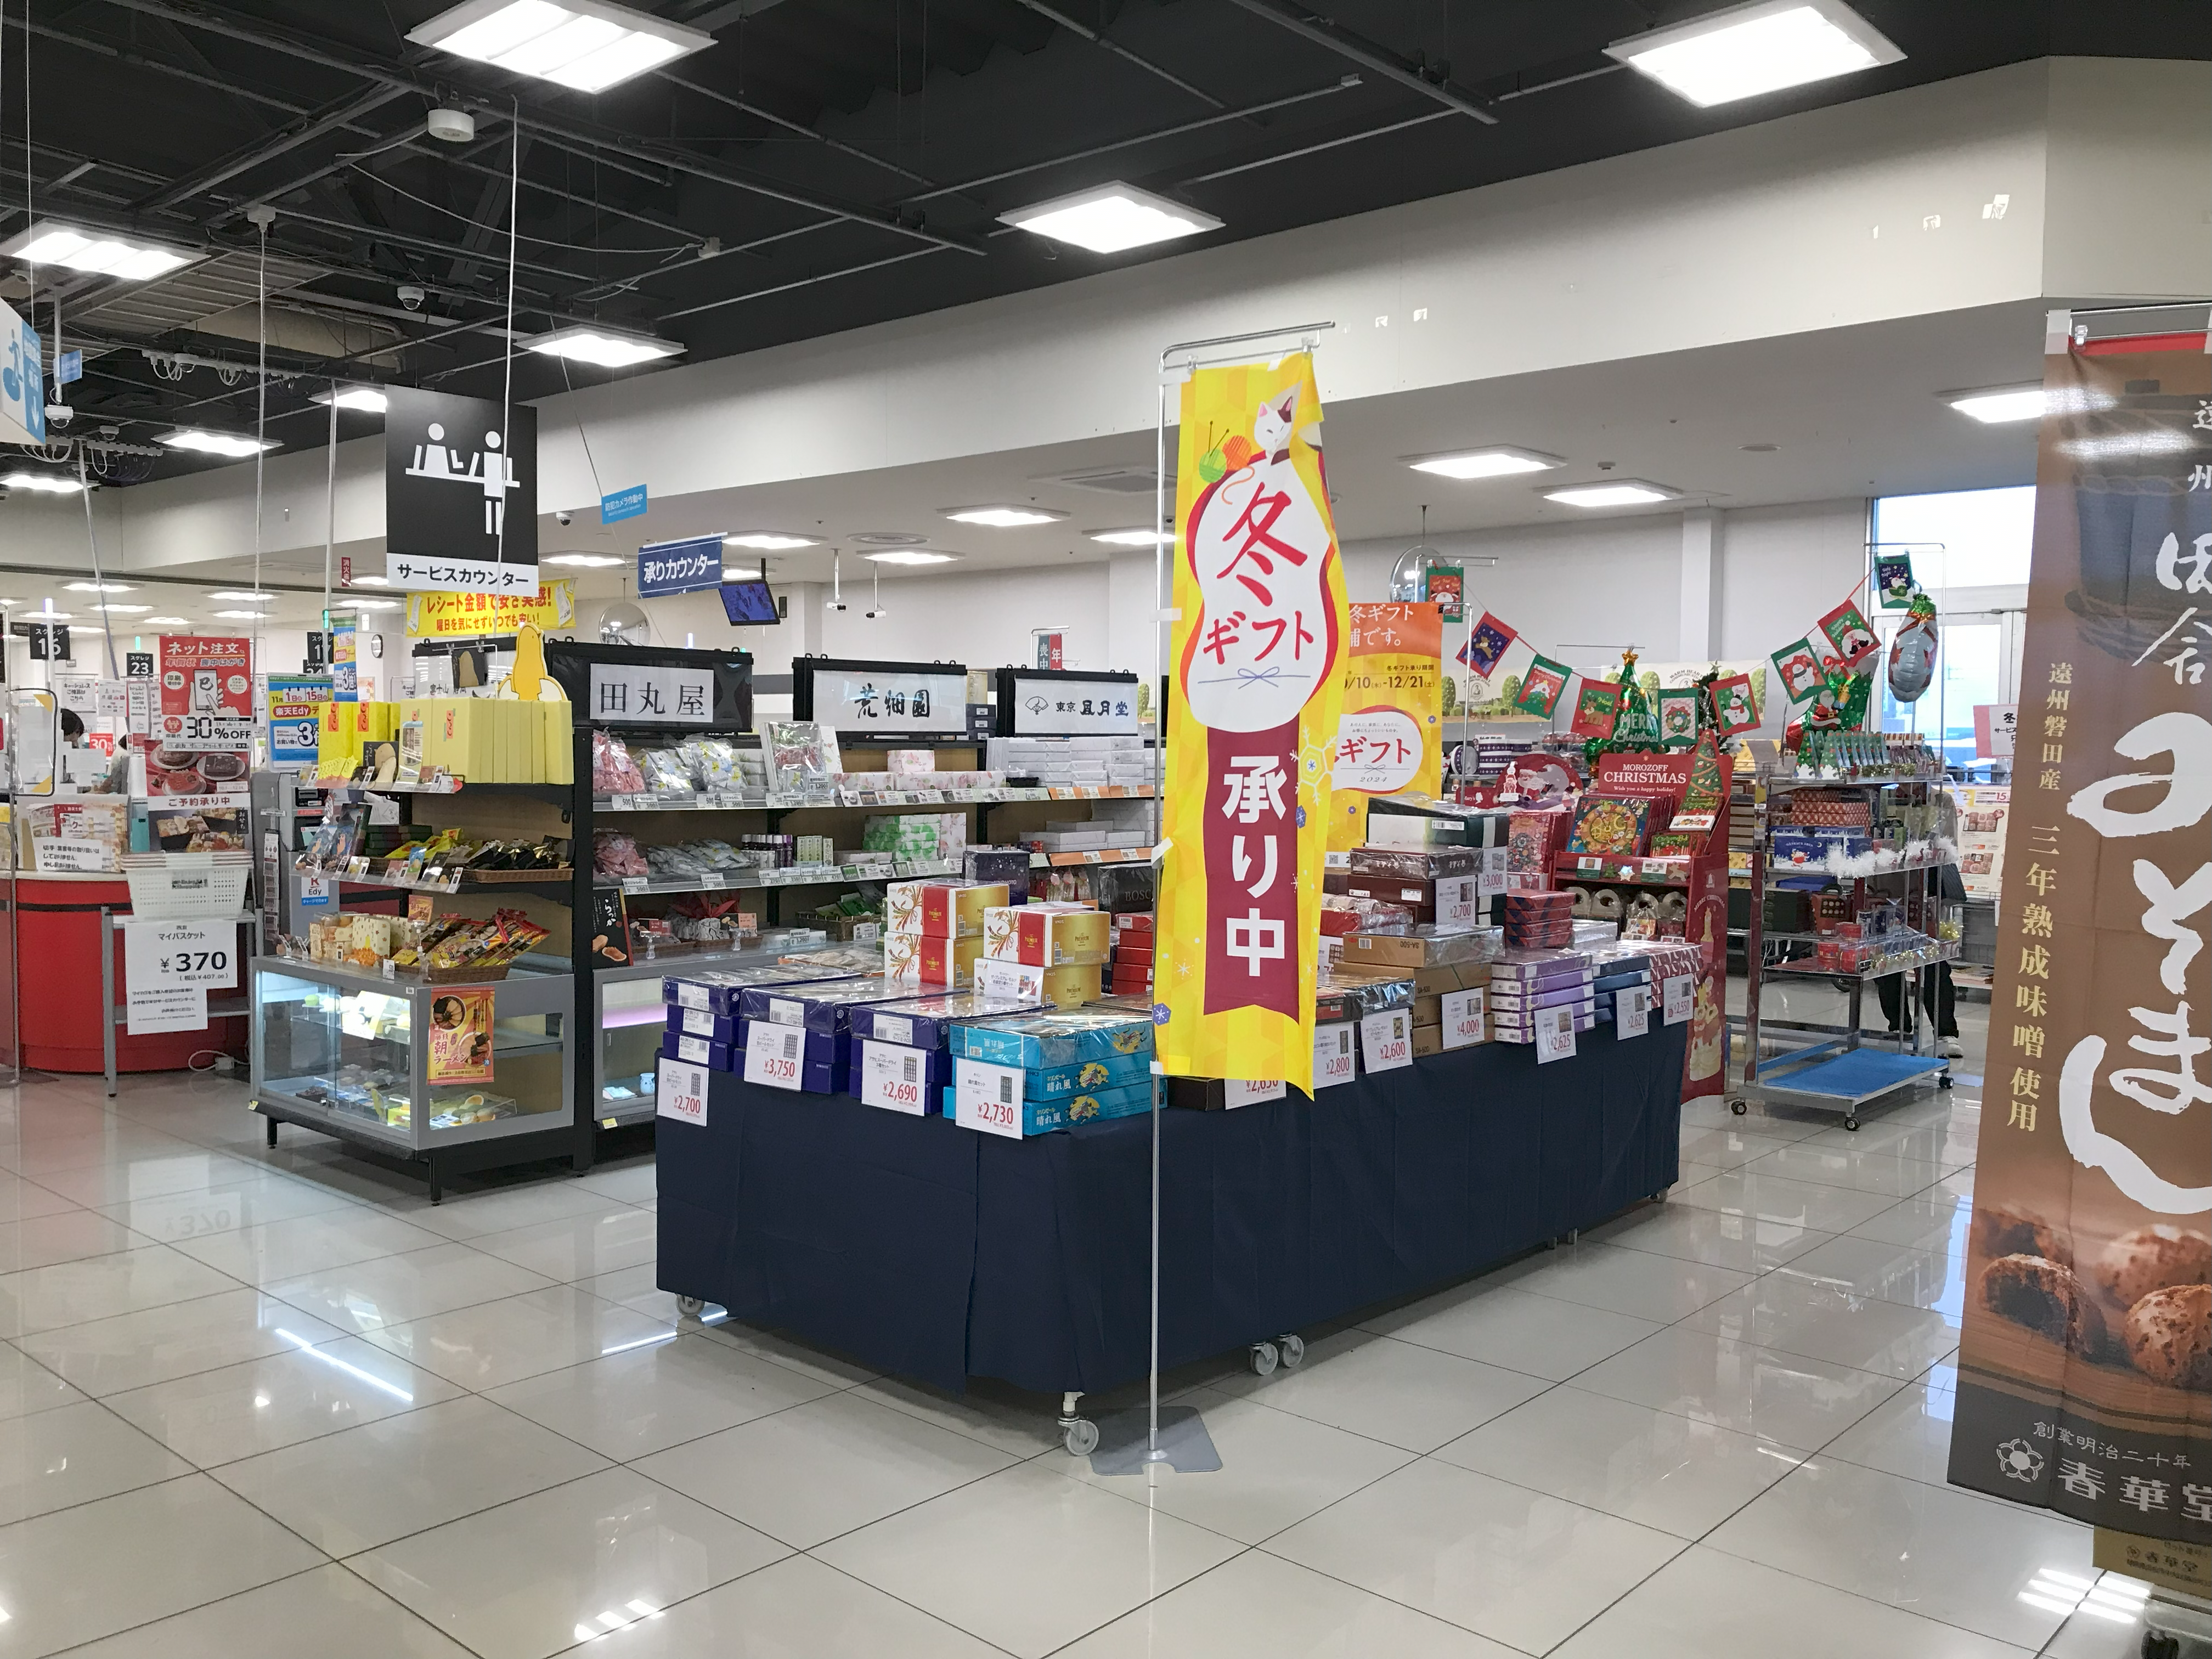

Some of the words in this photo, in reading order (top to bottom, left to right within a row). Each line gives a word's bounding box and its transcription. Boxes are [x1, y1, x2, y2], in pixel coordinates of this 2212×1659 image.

[605, 493, 644, 511] 防犯カメラ作動中
[1217, 481, 1308, 607] 冬
[397, 563, 529, 586] サービスカウンター
[644, 554, 719, 584] 承りカウンター
[1350, 604, 1414, 624] 冬ギフト
[1203, 610, 1313, 664] ギフト
[1039, 643, 1049, 669] 喪中
[1051, 647, 1062, 669] 年
[131, 663, 149, 674] 23
[600, 682, 705, 716] 田丸屋
[855, 682, 930, 719] 荒畑園
[1056, 702, 1076, 713] 東京
[2039, 663, 2073, 791] 遠州磐田産
[1335, 736, 1410, 764] ギフト
[1604, 772, 1686, 784] CHRISTMAS
[1623, 764, 1668, 772] MOROZOFF
[168, 797, 230, 807] ご予約承り中
[1996, 792, 2007, 800] 15
[1221, 755, 1288, 977] 承り中
[158, 932, 206, 940] マイバスケット
[176, 951, 227, 972] 370
[2007, 825, 2062, 1133] 三年熟成味噌使用
[1457, 1019, 1480, 1036] ¥4,000
[435, 1041, 448, 1055] 朝
[1380, 1041, 1406, 1060] ¥2,600
[433, 1054, 467, 1065] ラーメン
[764, 1058, 795, 1077] ¥3,750
[1325, 1056, 1350, 1075] ¥2,800
[883, 1081, 917, 1102] ¥2,690
[1047, 1079, 1071, 1092] 晴れ風
[674, 1094, 701, 1114] ¥2,700
[978, 1102, 1014, 1125] ¥2,730
[1036, 1112, 1061, 1126] 晴れ風
[2033, 1421, 2191, 1469] 創業明治二十年
[2058, 1457, 2212, 1522] 春華堂
